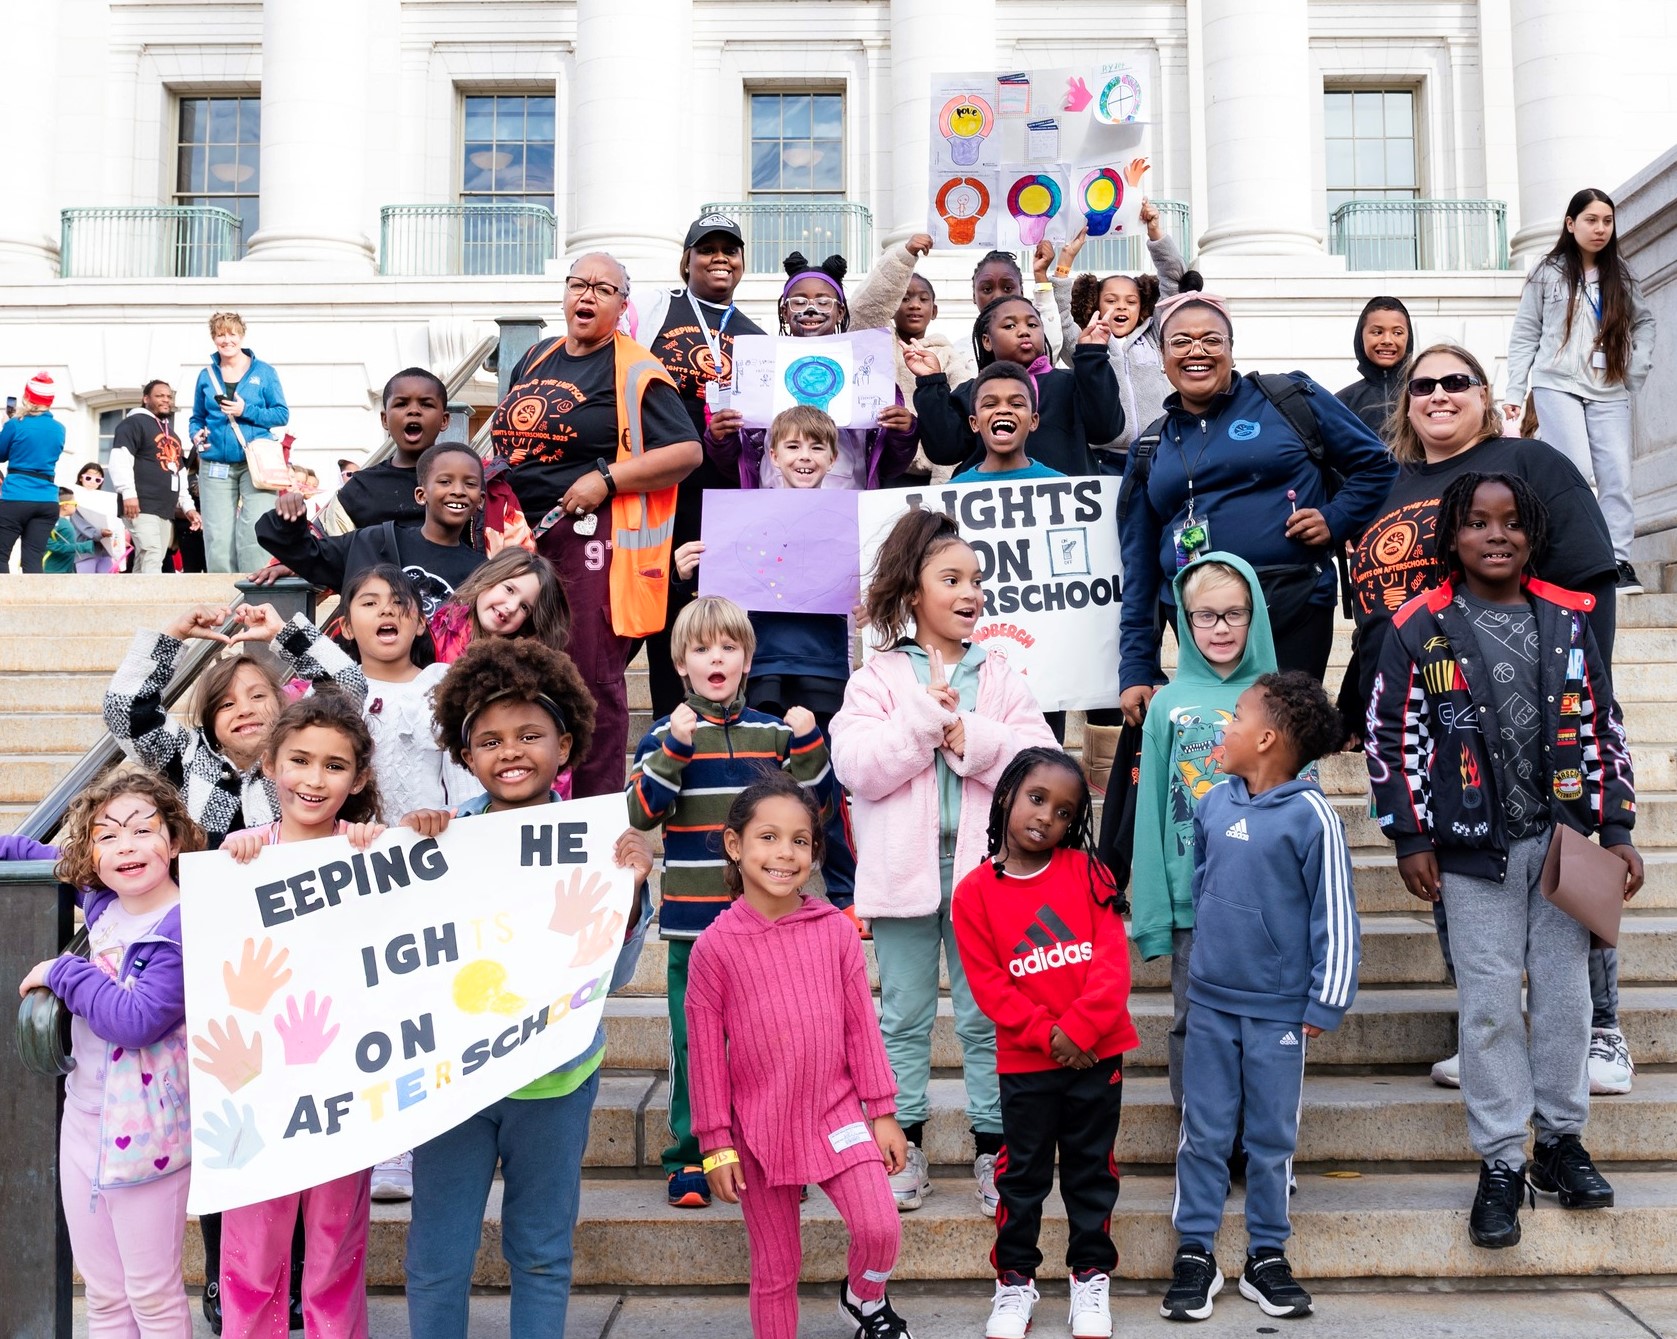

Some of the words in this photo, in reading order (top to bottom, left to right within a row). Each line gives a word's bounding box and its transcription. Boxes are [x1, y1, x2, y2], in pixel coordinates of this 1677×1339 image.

[663, 326, 701, 339] KEEPING
[666, 365, 688, 374] IGHTS
[906, 480, 1102, 530] IGHTS
[1373, 562, 1384, 576] ON
[1384, 558, 1430, 574] AFTERSCHOOL
[1225, 829, 1250, 842] adidas
[255, 838, 449, 927] EEPING
[520, 822, 588, 867] HE
[1008, 941, 1093, 978] adidas
[356, 1012, 436, 1073] ON
